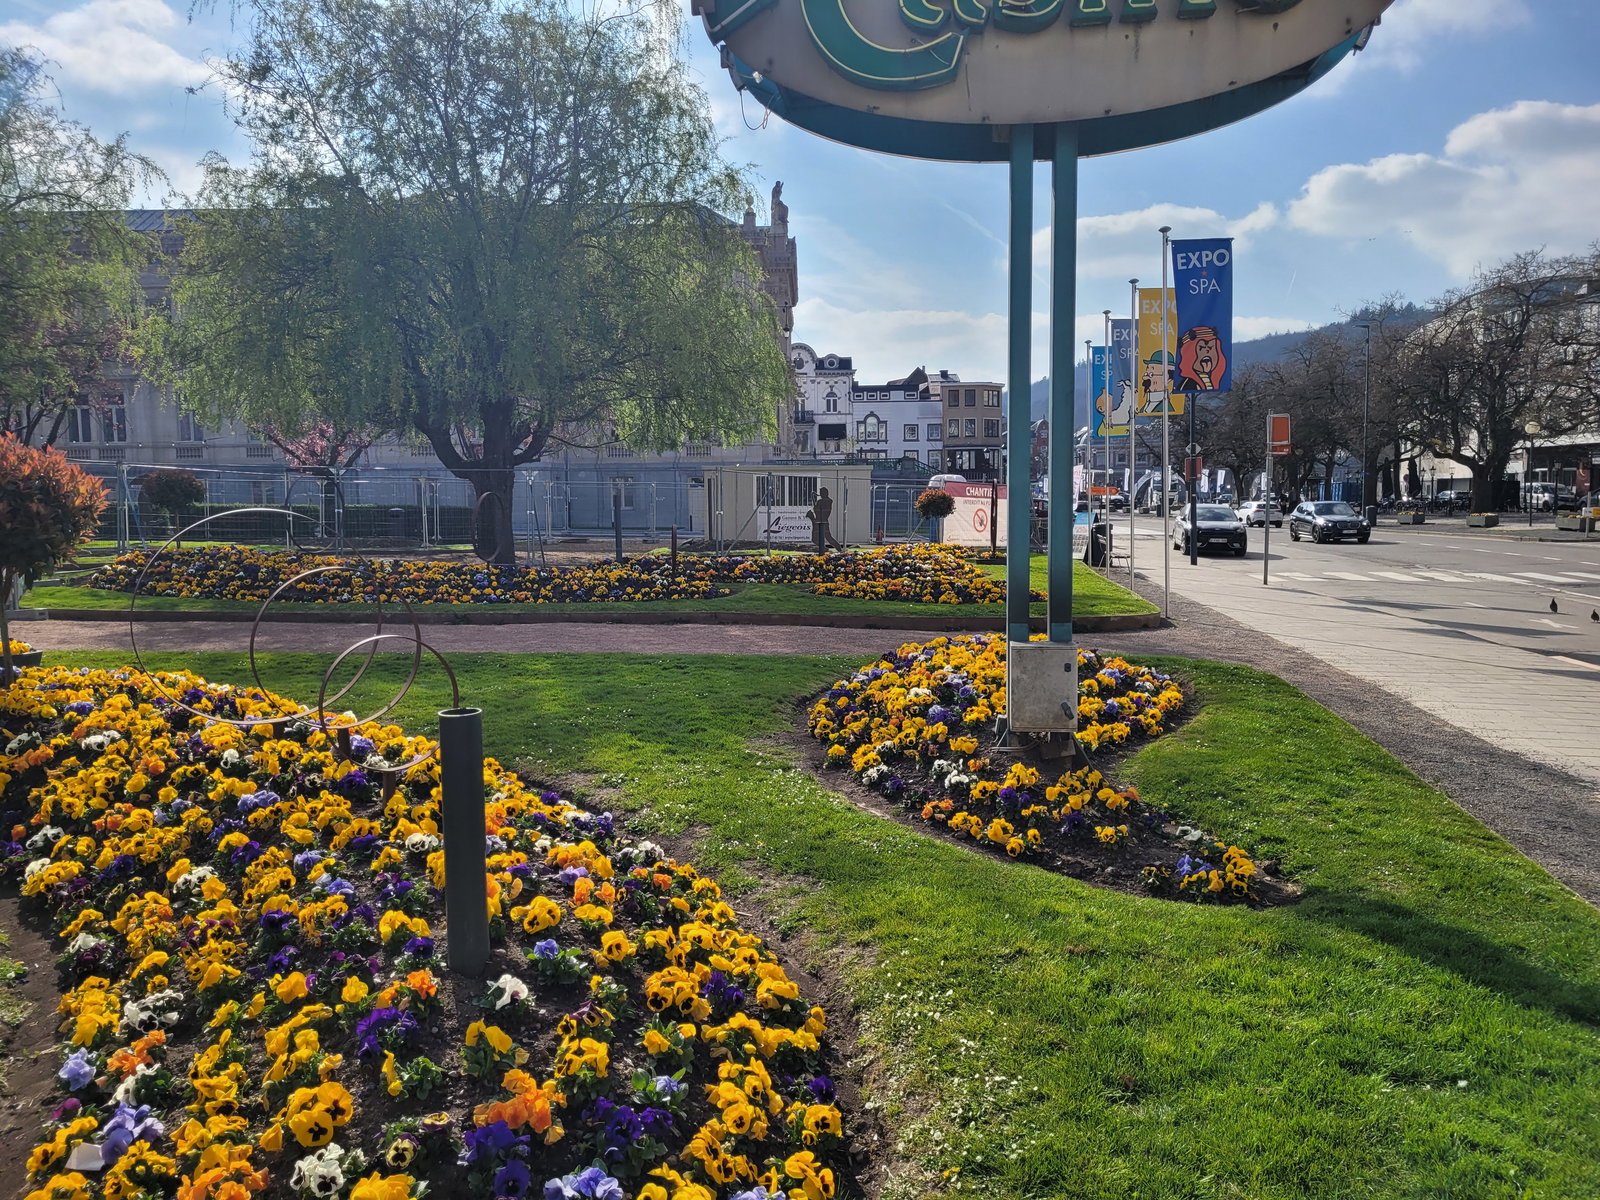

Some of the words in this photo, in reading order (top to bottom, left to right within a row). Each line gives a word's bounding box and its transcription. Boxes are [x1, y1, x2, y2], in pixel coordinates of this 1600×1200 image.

[1177, 249, 1230, 270] EXPO
[1189, 278, 1221, 294] SPA
[1113, 328, 1139, 341] EX
[1101, 370, 1113, 380] SP
[965, 486, 992, 497] CHANTIE
[763, 516, 811, 534] Liégeois
